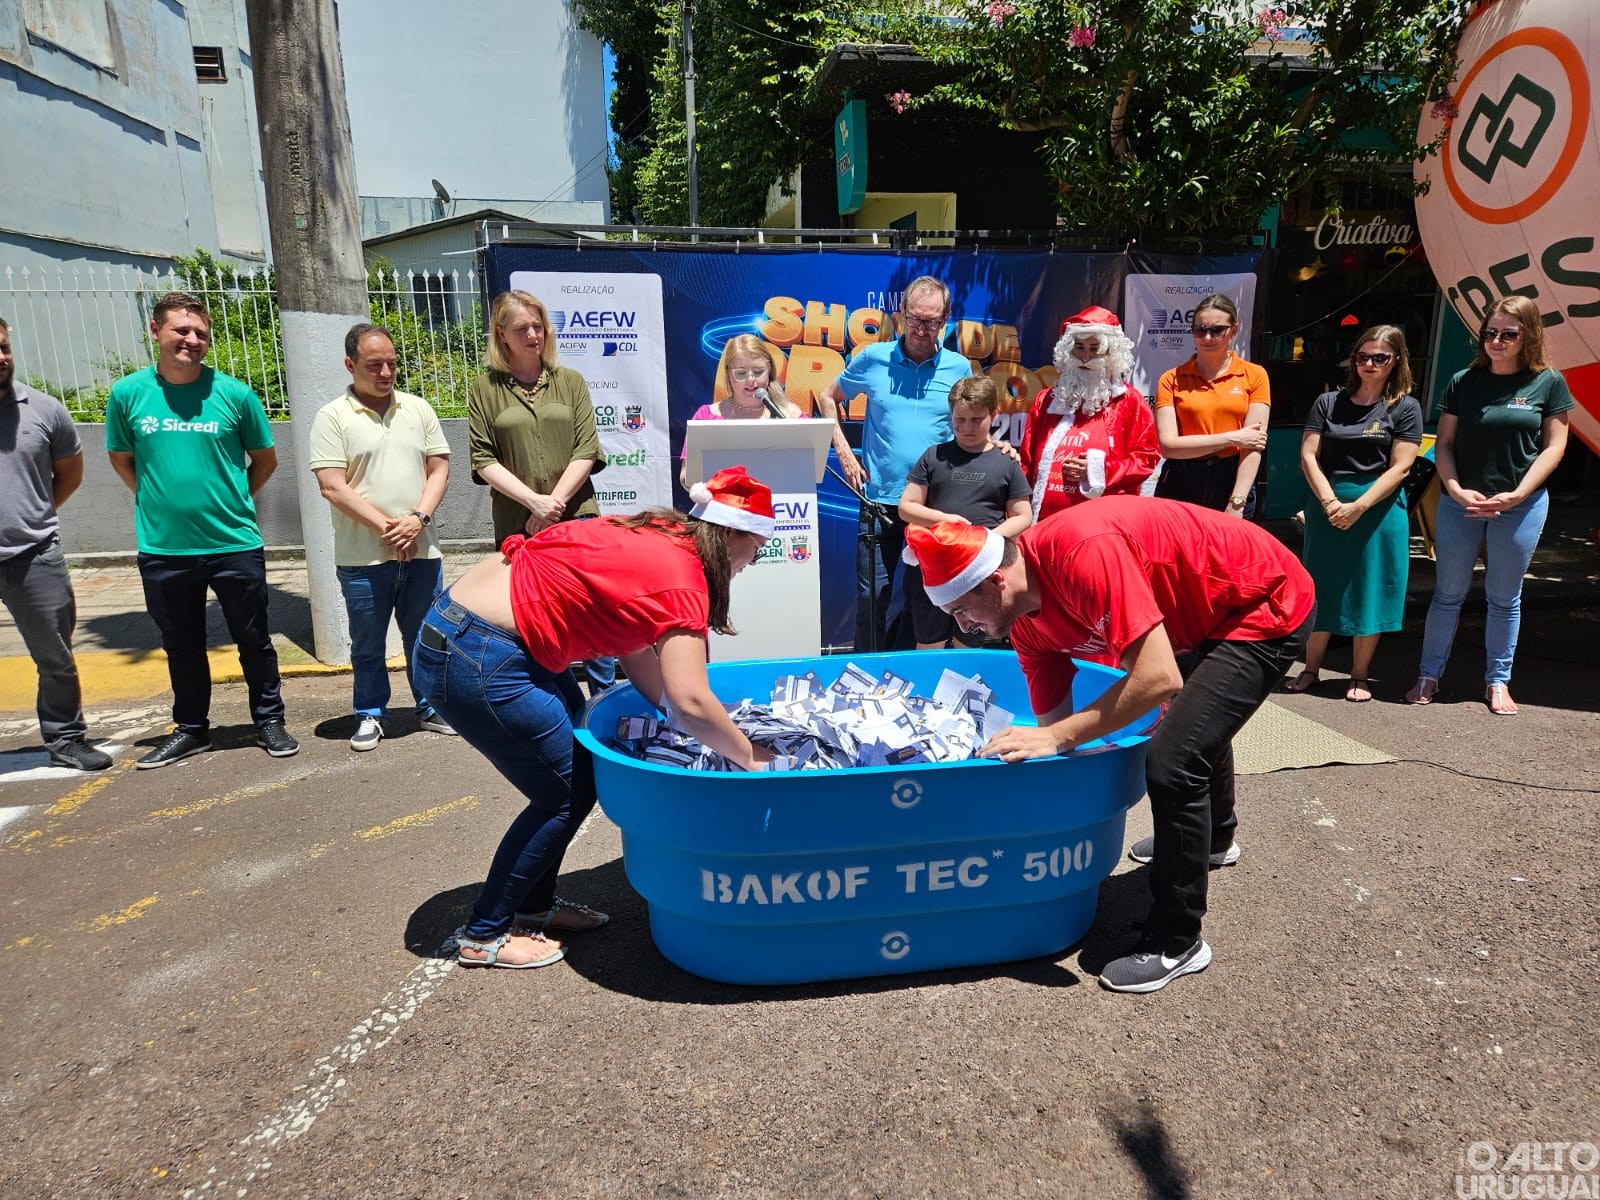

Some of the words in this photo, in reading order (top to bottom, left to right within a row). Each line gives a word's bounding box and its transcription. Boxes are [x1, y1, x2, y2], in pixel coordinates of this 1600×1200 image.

[1314, 215, 1414, 250] Criativa
[560, 285, 615, 295] REALIZAÇÃO
[569, 310, 636, 328] AEFW
[1170, 309, 1195, 324] AE
[760, 296, 948, 349] SHO
[957, 320, 1021, 361] DE
[618, 342, 639, 352] CDL
[162, 418, 219, 434] Sicredi
[991, 412, 1028, 447] 20
[1061, 435, 1083, 448] ATAL
[606, 449, 646, 466] redi
[596, 490, 637, 501] TRIFRED
[773, 502, 809, 519] FW
[702, 866, 870, 904] BAKOF
[896, 856, 989, 893] TEC
[1022, 839, 1093, 882] 500
